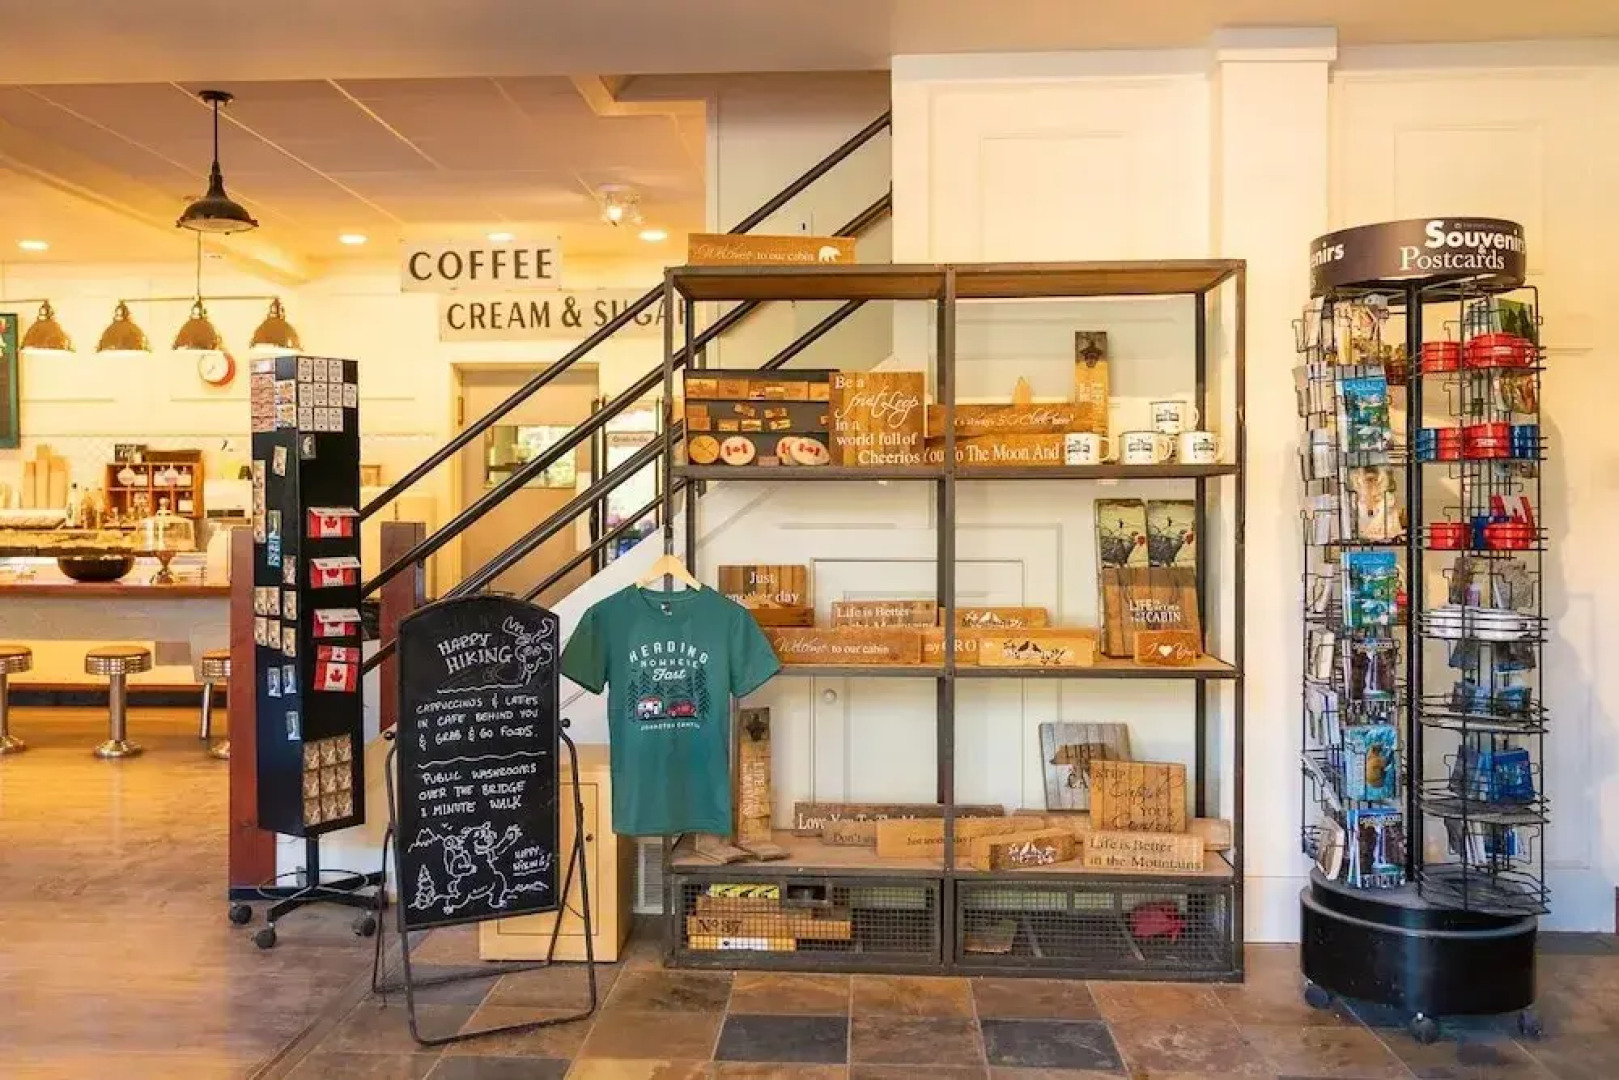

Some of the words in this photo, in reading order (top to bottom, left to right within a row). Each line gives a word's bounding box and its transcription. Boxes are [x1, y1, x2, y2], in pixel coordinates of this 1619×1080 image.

[787, 250, 814, 261] cabin
[1400, 245, 1505, 271] Postcards
[409, 248, 552, 281] COFFEE
[447, 301, 550, 330] CREAM
[562, 296, 582, 328] &
[835, 375, 853, 390] Be
[856, 379, 865, 389] a
[836, 420, 848, 431] in
[836, 433, 874, 446] world
[879, 432, 901, 445] full
[903, 432, 918, 445] of
[858, 449, 920, 464] Cheerios
[966, 445, 990, 462] The
[993, 444, 1029, 462] Moon
[1032, 443, 1060, 461] And
[749, 571, 775, 584] Just
[775, 590, 801, 605] day
[1129, 598, 1153, 611] LIFE
[837, 606, 862, 618] Life
[1146, 611, 1181, 623] CABIN
[437, 632, 492, 657] HAPPY
[831, 645, 841, 653] to
[842, 646, 861, 654] our
[862, 644, 890, 655] cabin
[445, 645, 513, 674] HIKING
[629, 640, 709, 665] HEADING
[652, 667, 687, 682] Fast
[417, 718, 428, 729] IN
[475, 710, 514, 723] BEHIND
[519, 708, 539, 719] YOU
[418, 732, 427, 752] &
[435, 729, 462, 746] GRAB
[468, 726, 475, 743] &
[421, 770, 462, 785] PUBLIC
[471, 762, 537, 780] WASHROOMS
[418, 786, 452, 801] OVER
[453, 784, 475, 798] THE
[481, 779, 526, 796] BRIDGE
[432, 801, 477, 816] MINUTE
[489, 794, 522, 810] WALK
[1089, 837, 1117, 850] Life
[1119, 840, 1131, 850] is
[1133, 839, 1173, 853] Better
[1088, 856, 1102, 867] in
[1107, 855, 1126, 867] the
[1131, 856, 1202, 870] Mountains
